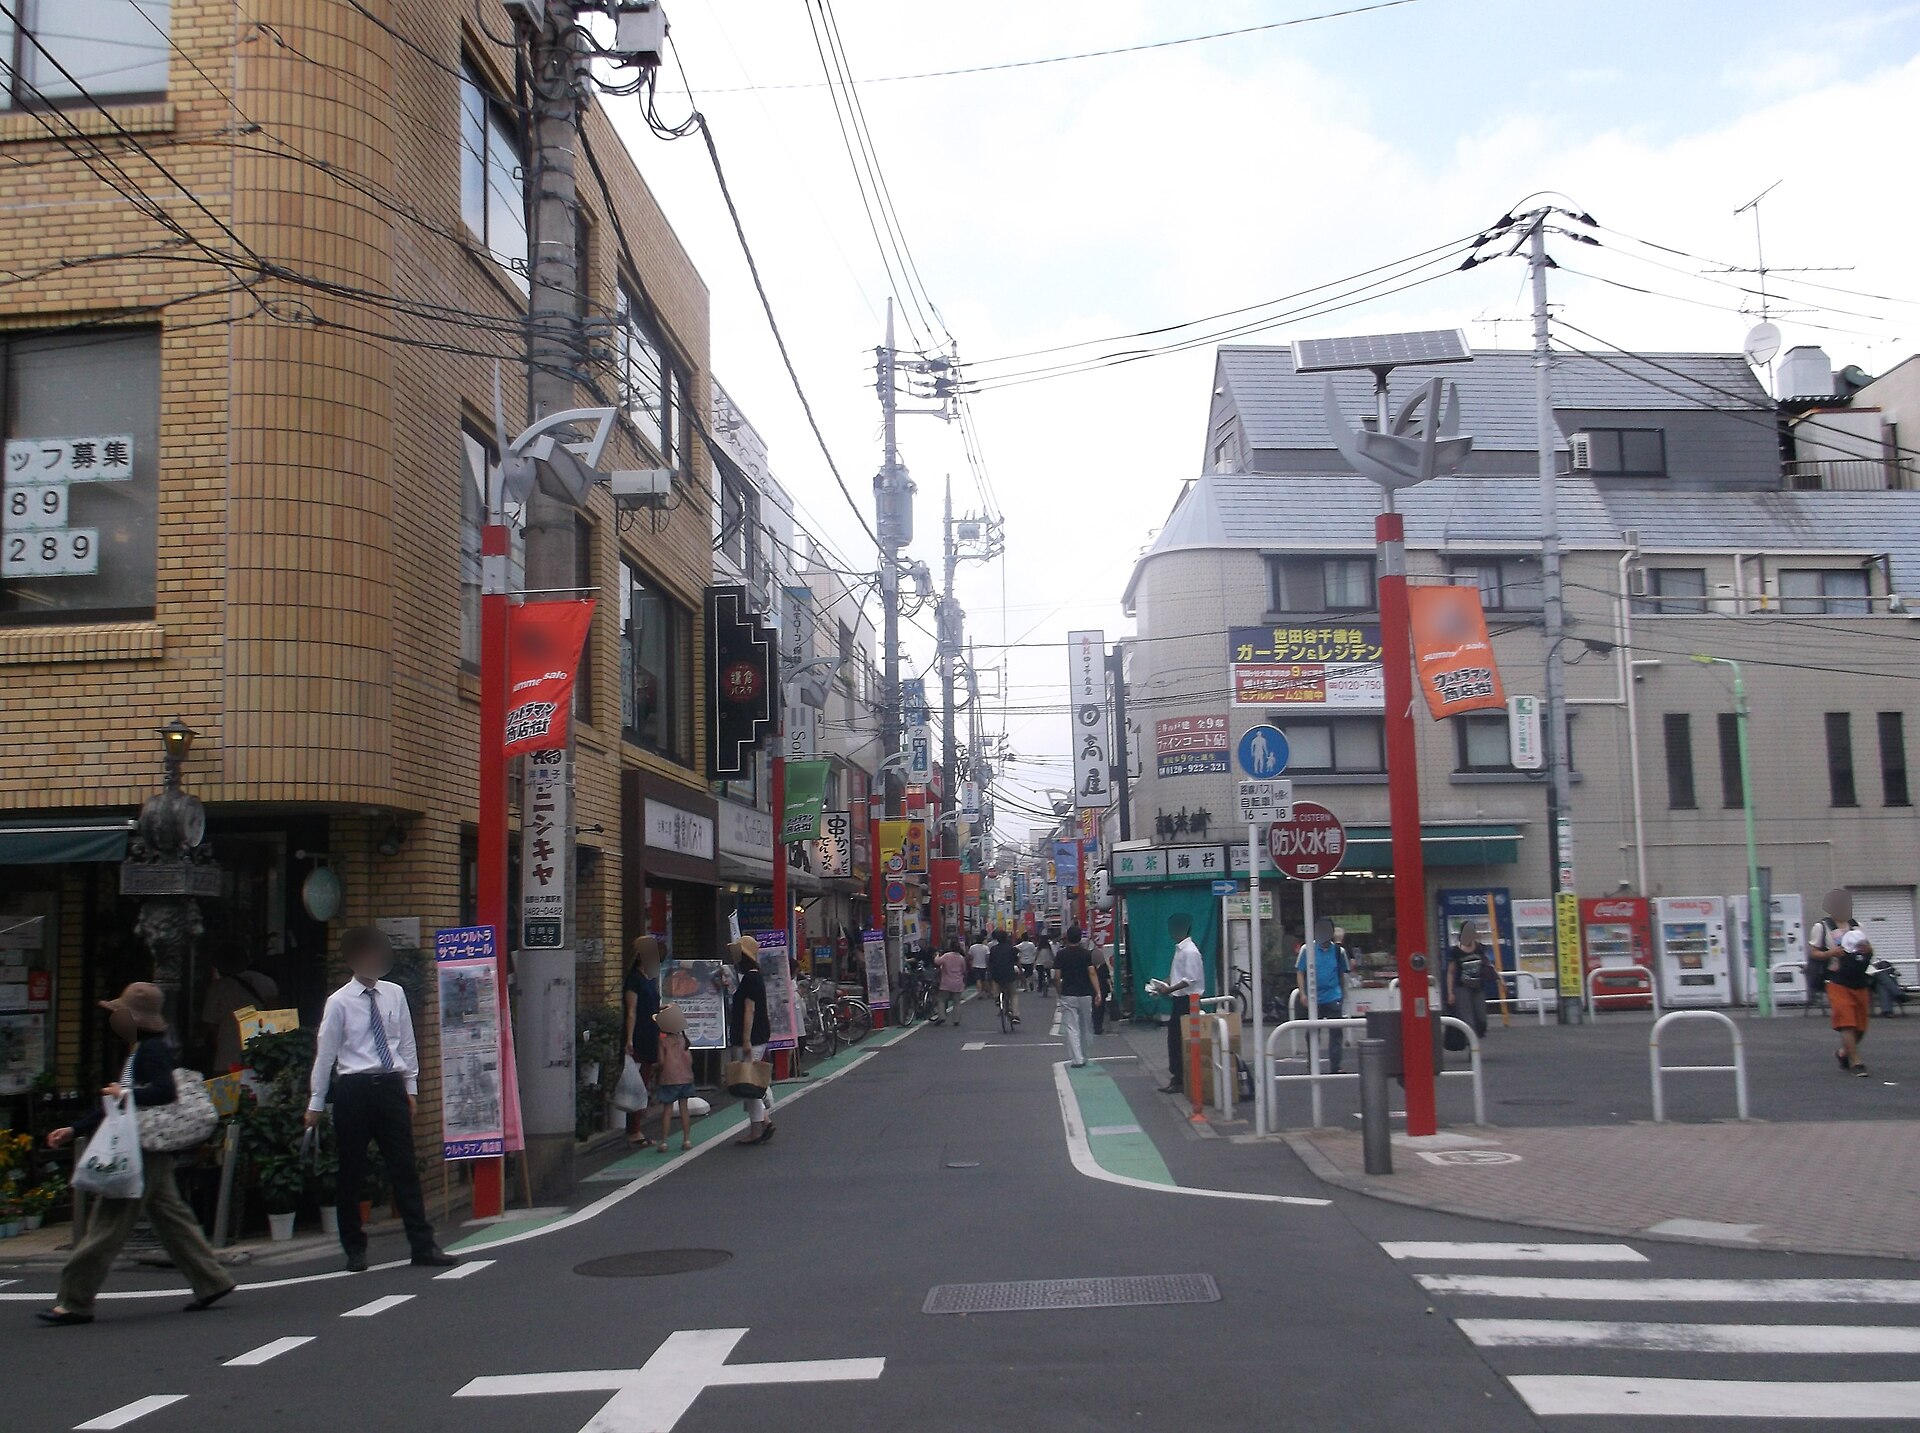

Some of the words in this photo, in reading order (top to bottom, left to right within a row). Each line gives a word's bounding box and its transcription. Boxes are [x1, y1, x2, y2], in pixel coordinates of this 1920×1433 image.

[11, 441, 129, 473] ッフ募集
[1273, 629, 1363, 644] 世田谷千歳台
[1442, 682, 1494, 704] 商店街
[1078, 703, 1107, 797] 日高屋
[1241, 796, 1271, 807] 自転車
[1243, 809, 1254, 820] 16
[1275, 808, 1287, 819] 18
[1299, 813, 1331, 822] CISTERN
[1271, 828, 1342, 856] 防火水槽
[1121, 856, 1158, 872] 銘茶
[1177, 852, 1216, 869] 海苔
[1235, 859, 1266, 867] コーー
[1466, 894, 1490, 905] BOS
[437, 929, 492, 945] 2014ウルトラ
[438, 945, 493, 960] サマーセール
